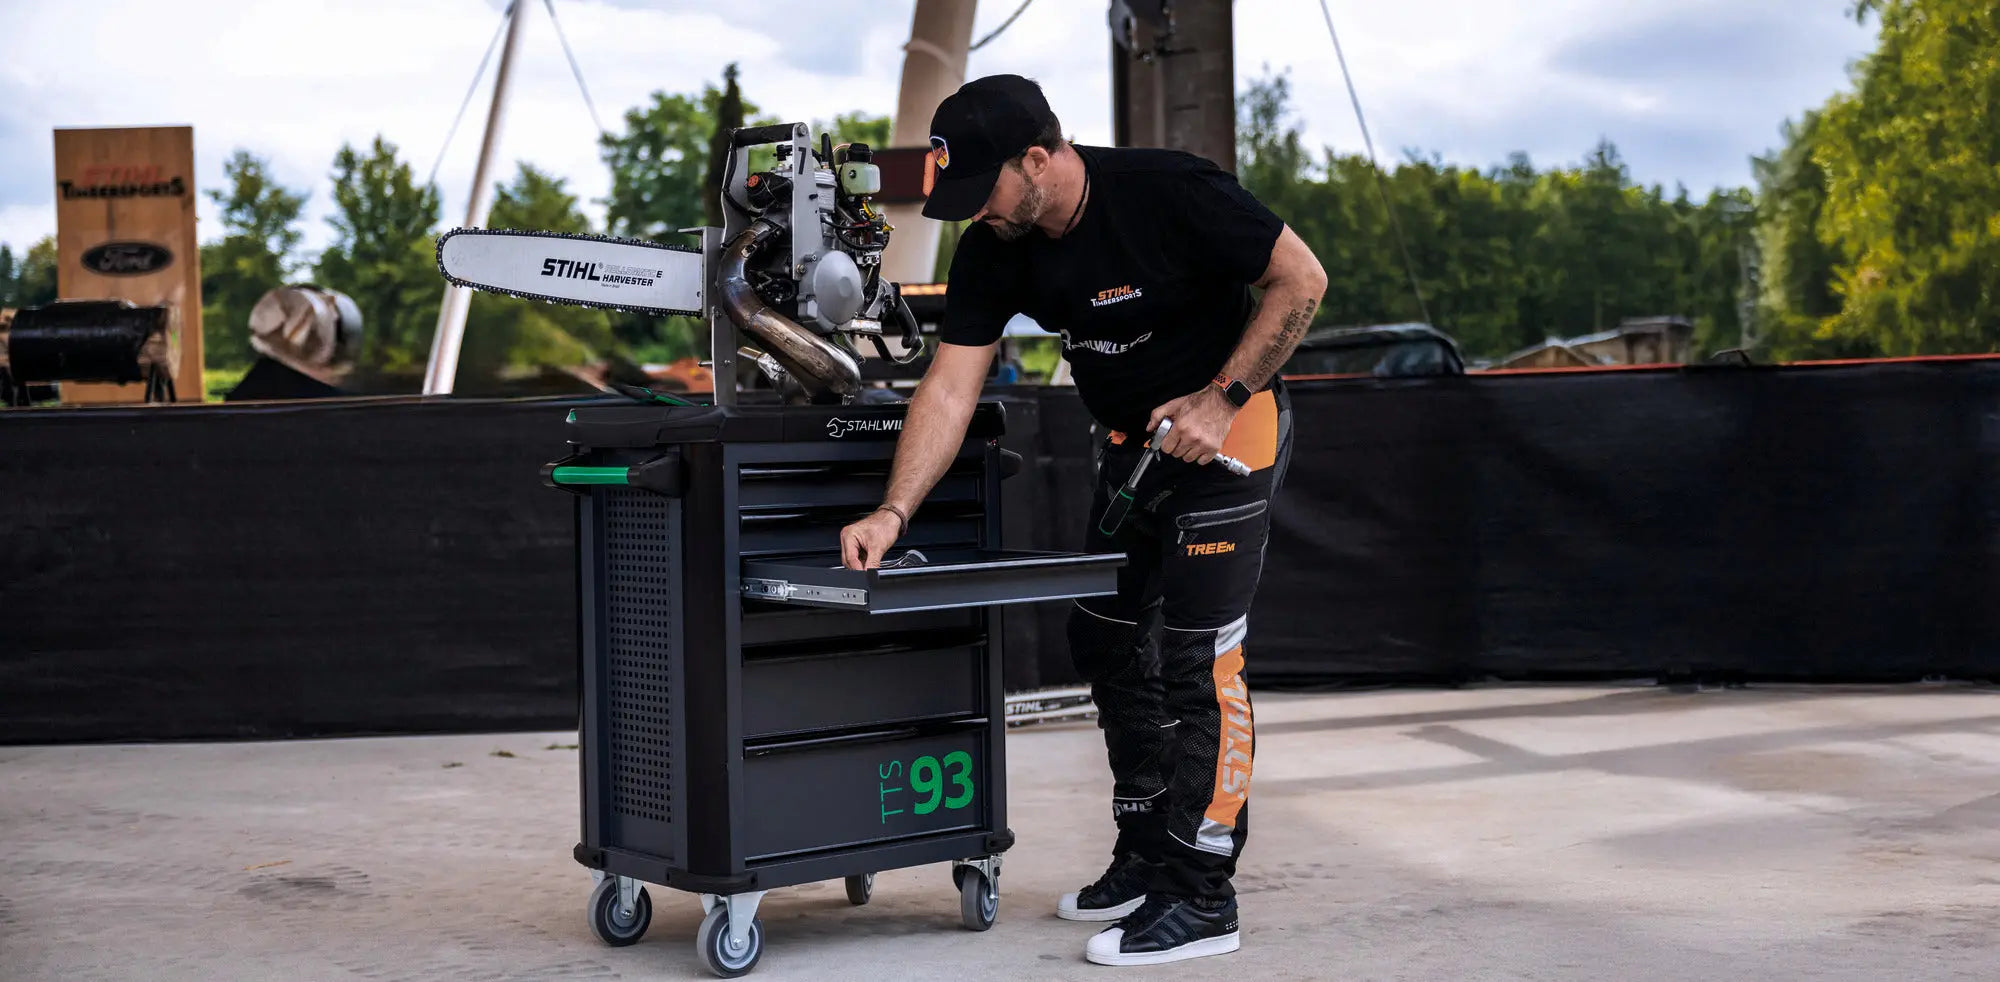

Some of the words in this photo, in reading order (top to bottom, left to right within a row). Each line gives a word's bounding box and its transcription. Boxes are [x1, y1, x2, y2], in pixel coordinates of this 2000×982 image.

[798, 146, 807, 175] 7
[541, 257, 600, 281] STIHL
[602, 273, 654, 287] HARVESTER
[1090, 287, 1143, 307] TIMBERSPORTS
[1097, 284, 1134, 301] STIHL
[1221, 674, 1252, 800] STIHL
[879, 760, 904, 825] TTS
[909, 750, 975, 815] 93
